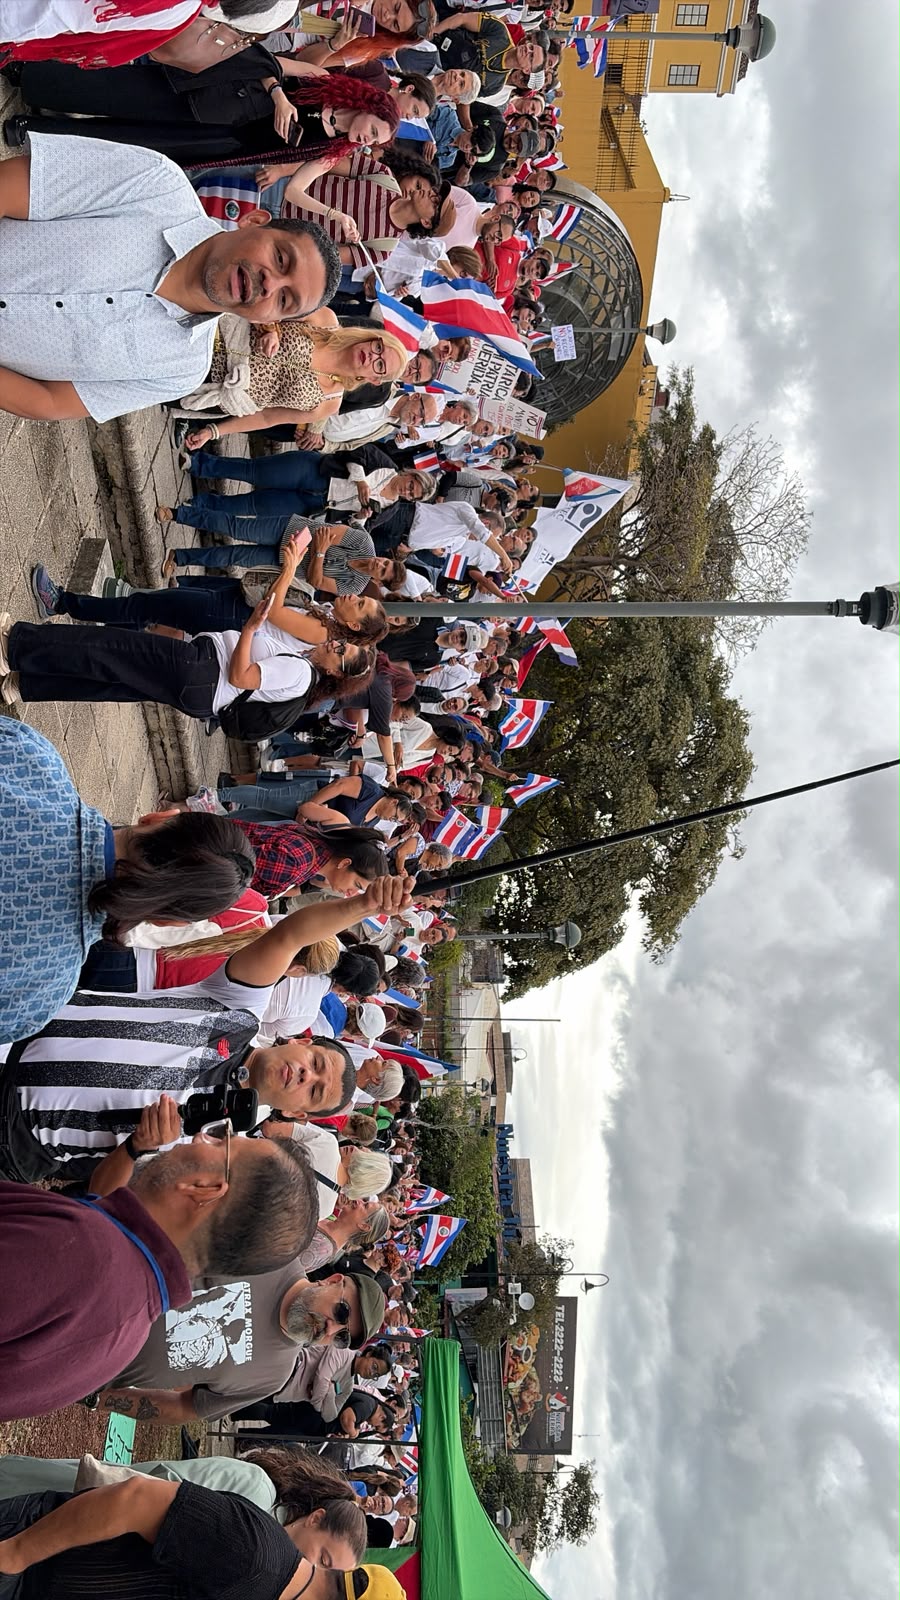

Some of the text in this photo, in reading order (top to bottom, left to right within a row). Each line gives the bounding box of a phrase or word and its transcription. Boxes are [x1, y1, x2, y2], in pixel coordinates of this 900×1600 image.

[492, 364, 518, 402] TARICA
[526, 411, 538, 426] NO
[496, 1124, 516, 1207] Nuestra
[244, 1282, 252, 1314] ATRAX
